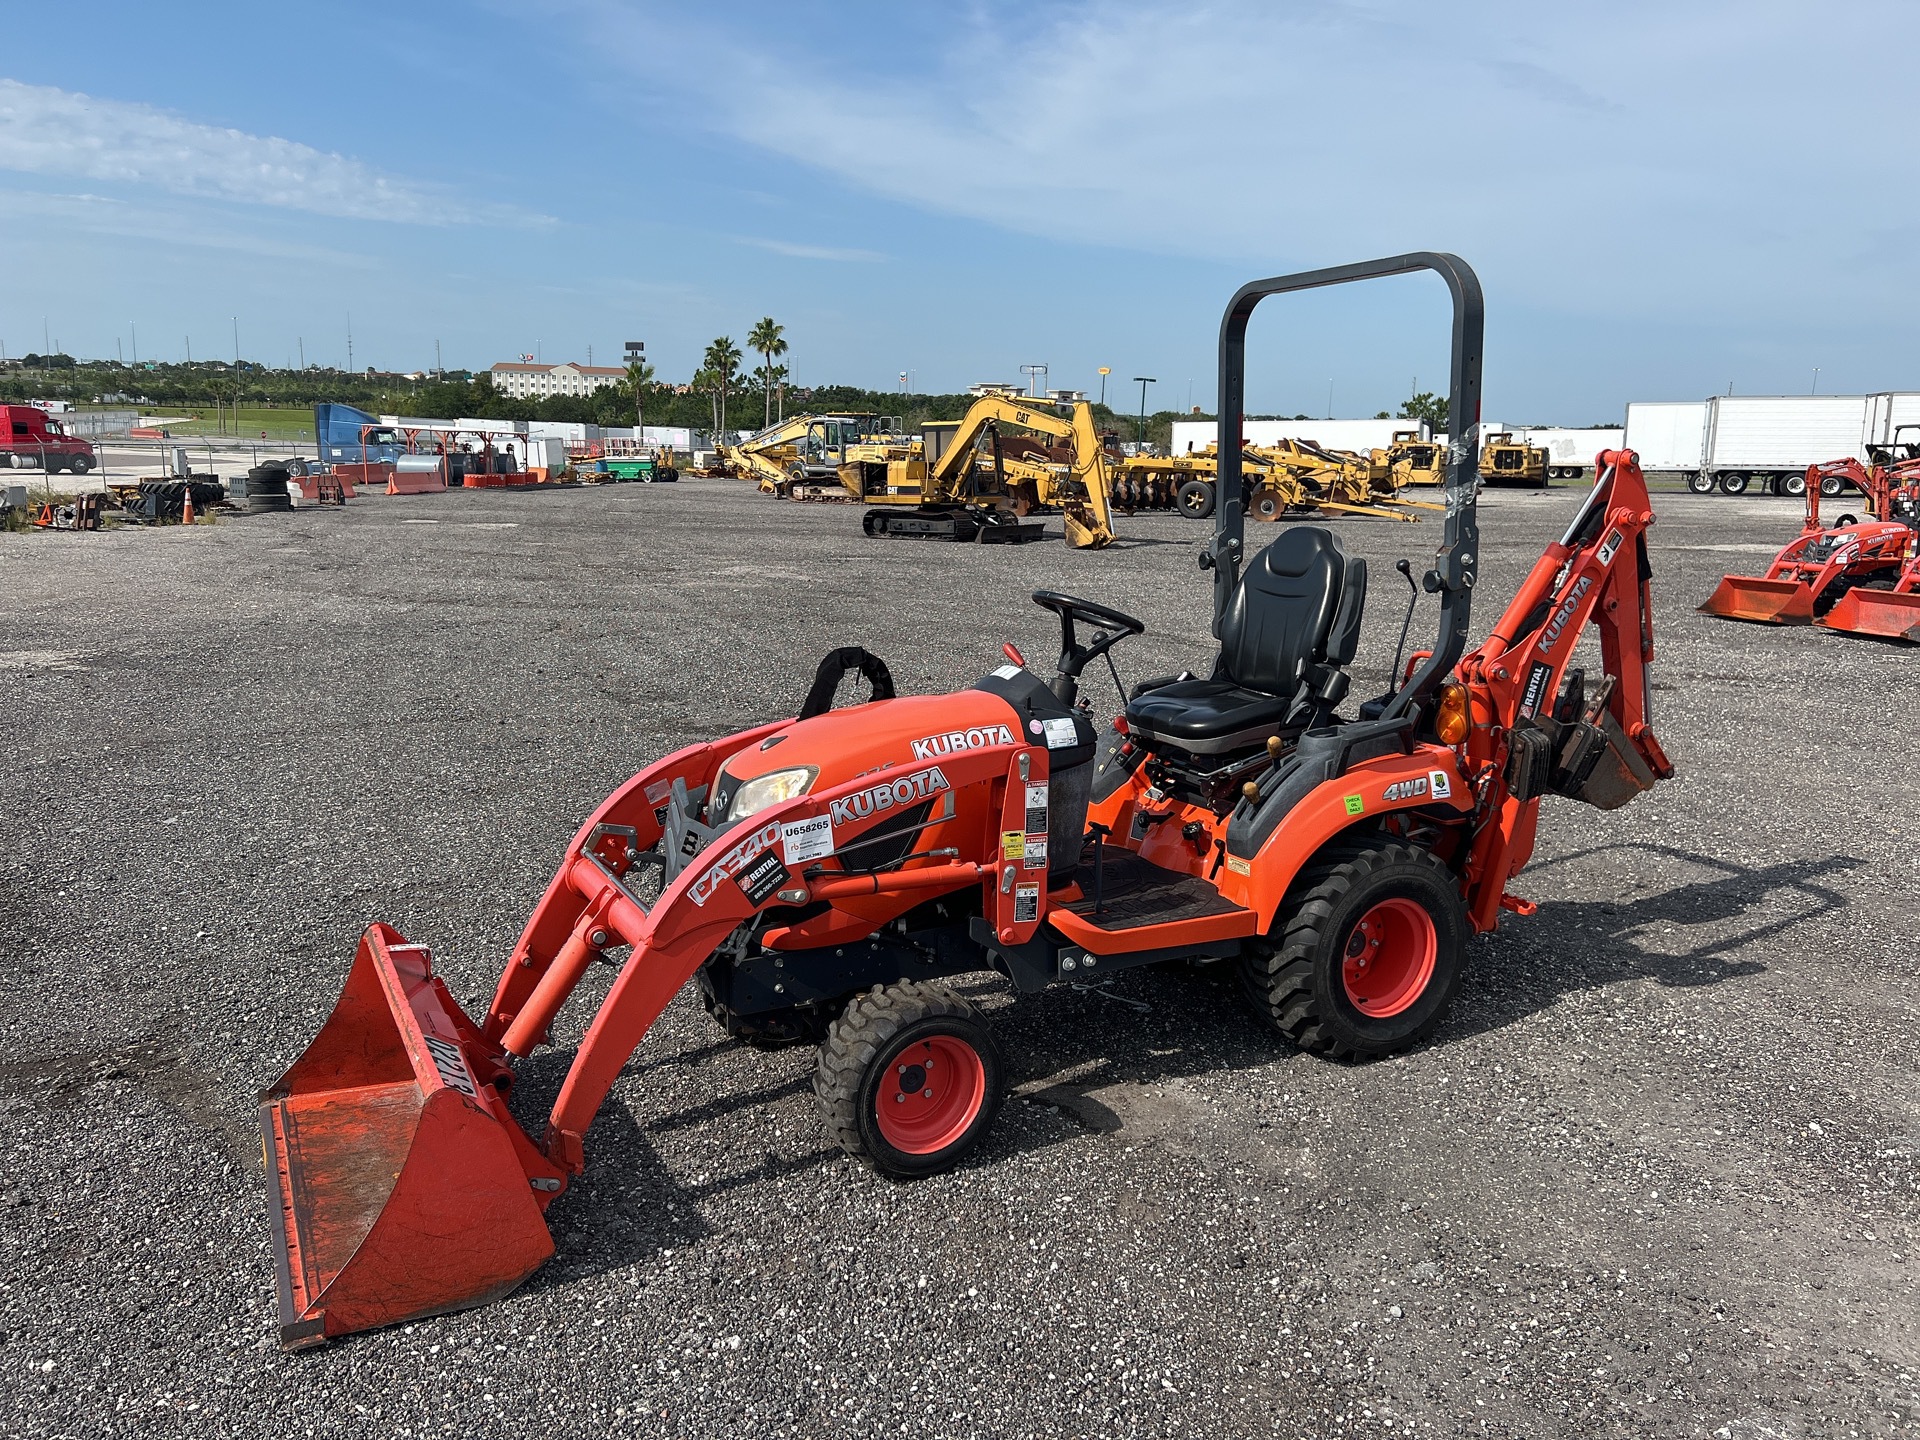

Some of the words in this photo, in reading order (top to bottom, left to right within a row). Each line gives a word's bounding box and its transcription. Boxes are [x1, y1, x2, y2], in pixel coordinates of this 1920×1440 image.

[1016, 412, 1030, 424] CAT
[1868, 534, 1894, 544] KUBOTA
[1538, 576, 1593, 654] KUBOTA
[1525, 667, 1544, 706] RENTAL
[911, 725, 1015, 760] KUBOTA
[831, 767, 949, 825] KUBOTA
[1383, 778, 1427, 801] 4WD
[786, 820, 829, 837] U658265
[750, 857, 778, 881] RENTAL
